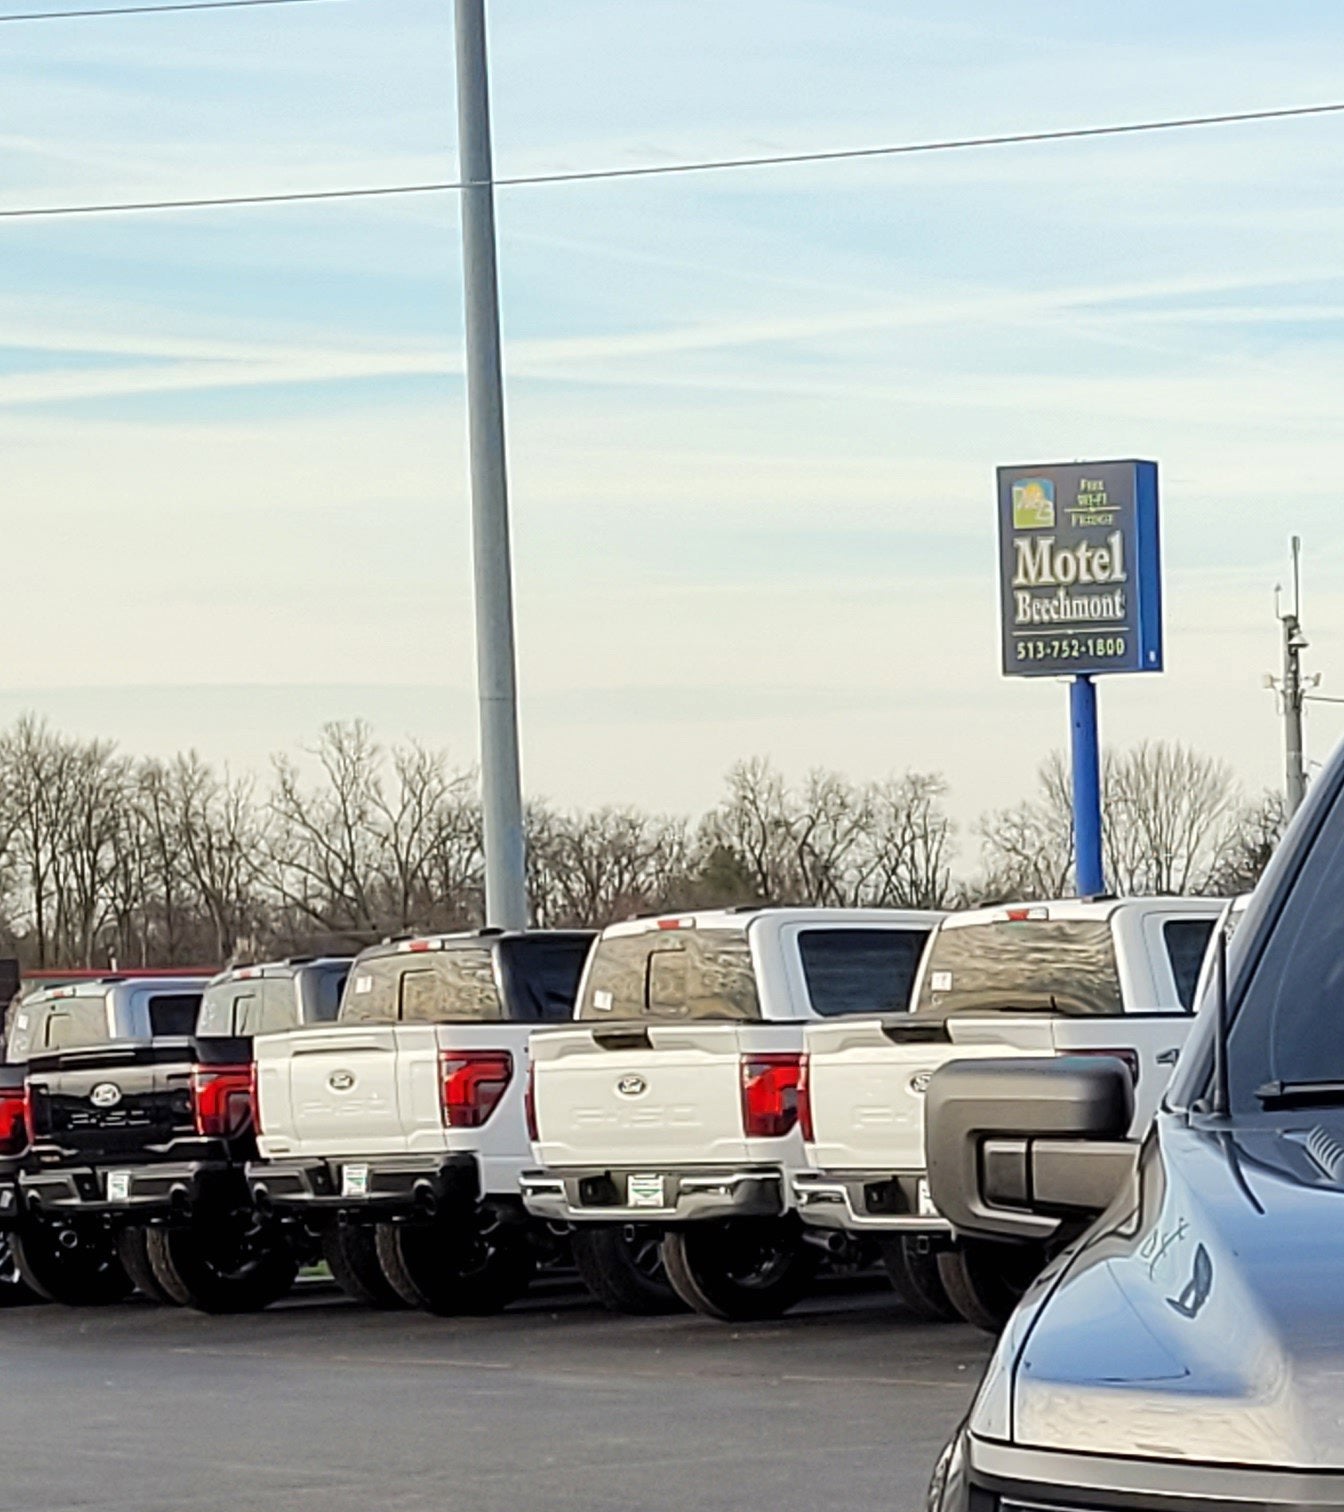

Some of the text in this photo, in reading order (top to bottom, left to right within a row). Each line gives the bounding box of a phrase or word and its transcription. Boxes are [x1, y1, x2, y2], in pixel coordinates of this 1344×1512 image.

[1012, 530, 1127, 586] Motel
[1014, 587, 1125, 624] Beechmont
[1017, 638, 1125, 660] 513-752-1800
